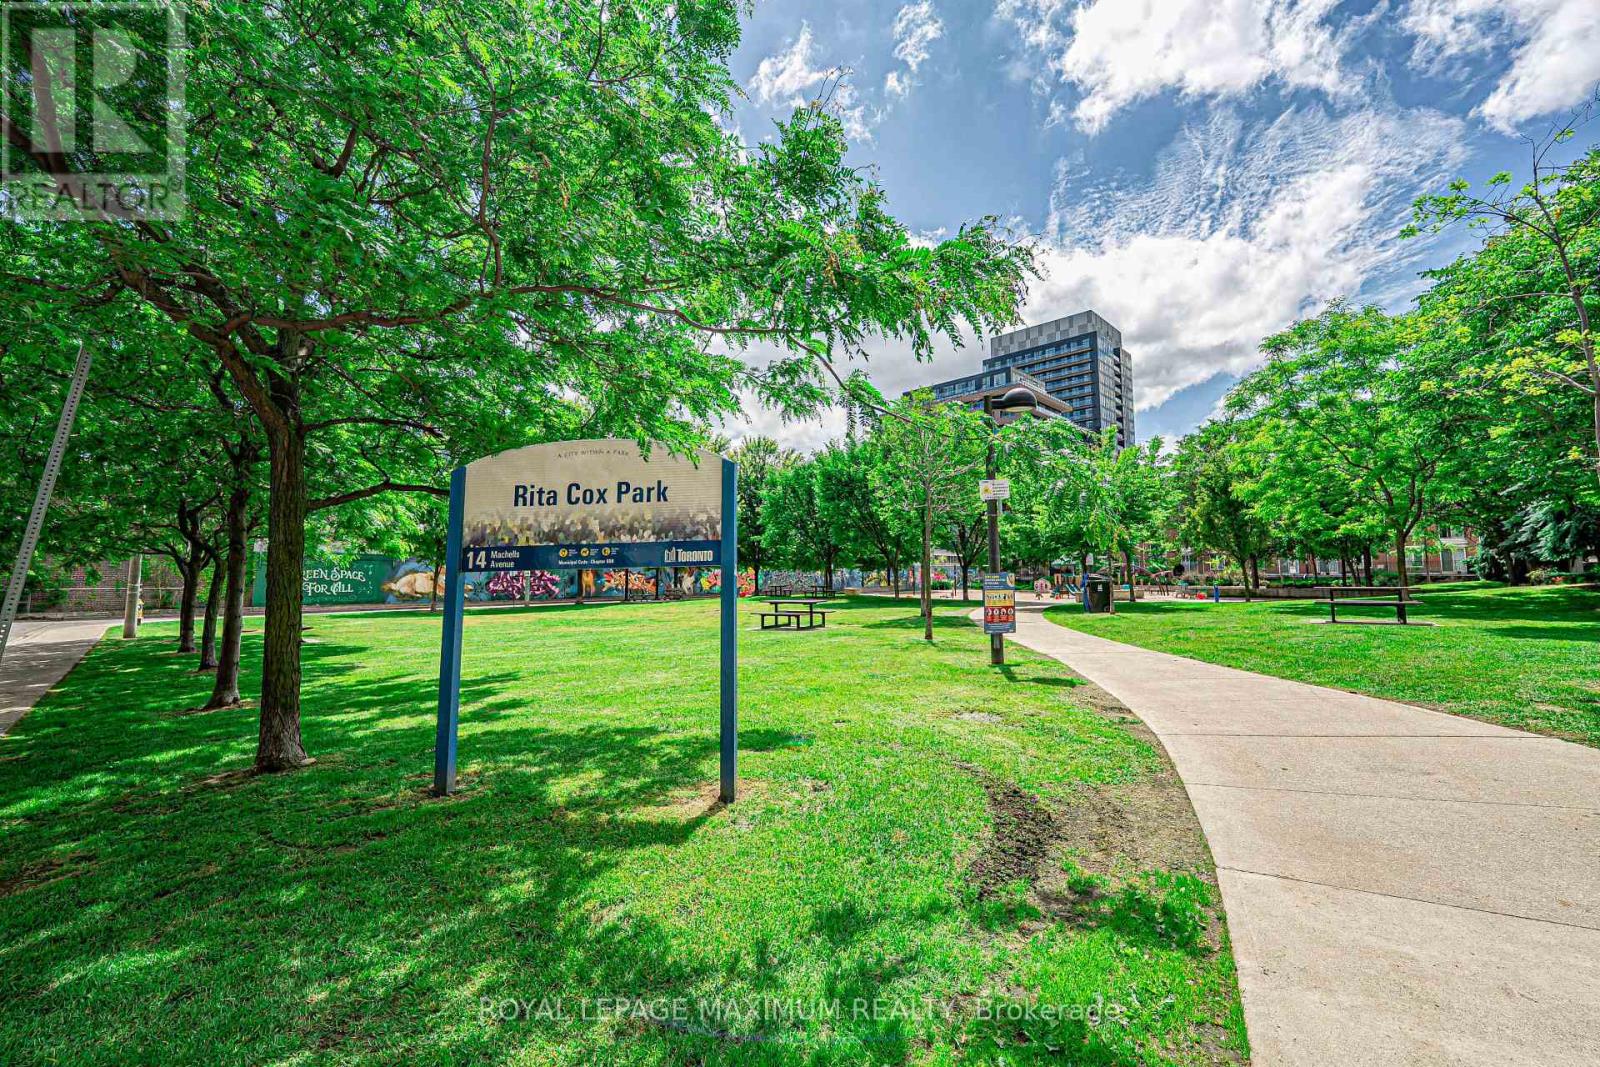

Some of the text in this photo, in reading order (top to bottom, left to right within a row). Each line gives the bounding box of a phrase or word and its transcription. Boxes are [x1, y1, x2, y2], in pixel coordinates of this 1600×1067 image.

[513, 479, 669, 507] Rita Cox Park
[466, 550, 487, 569] 14
[676, 548, 714, 563] TORONTO
[490, 560, 515, 569] Avenue
